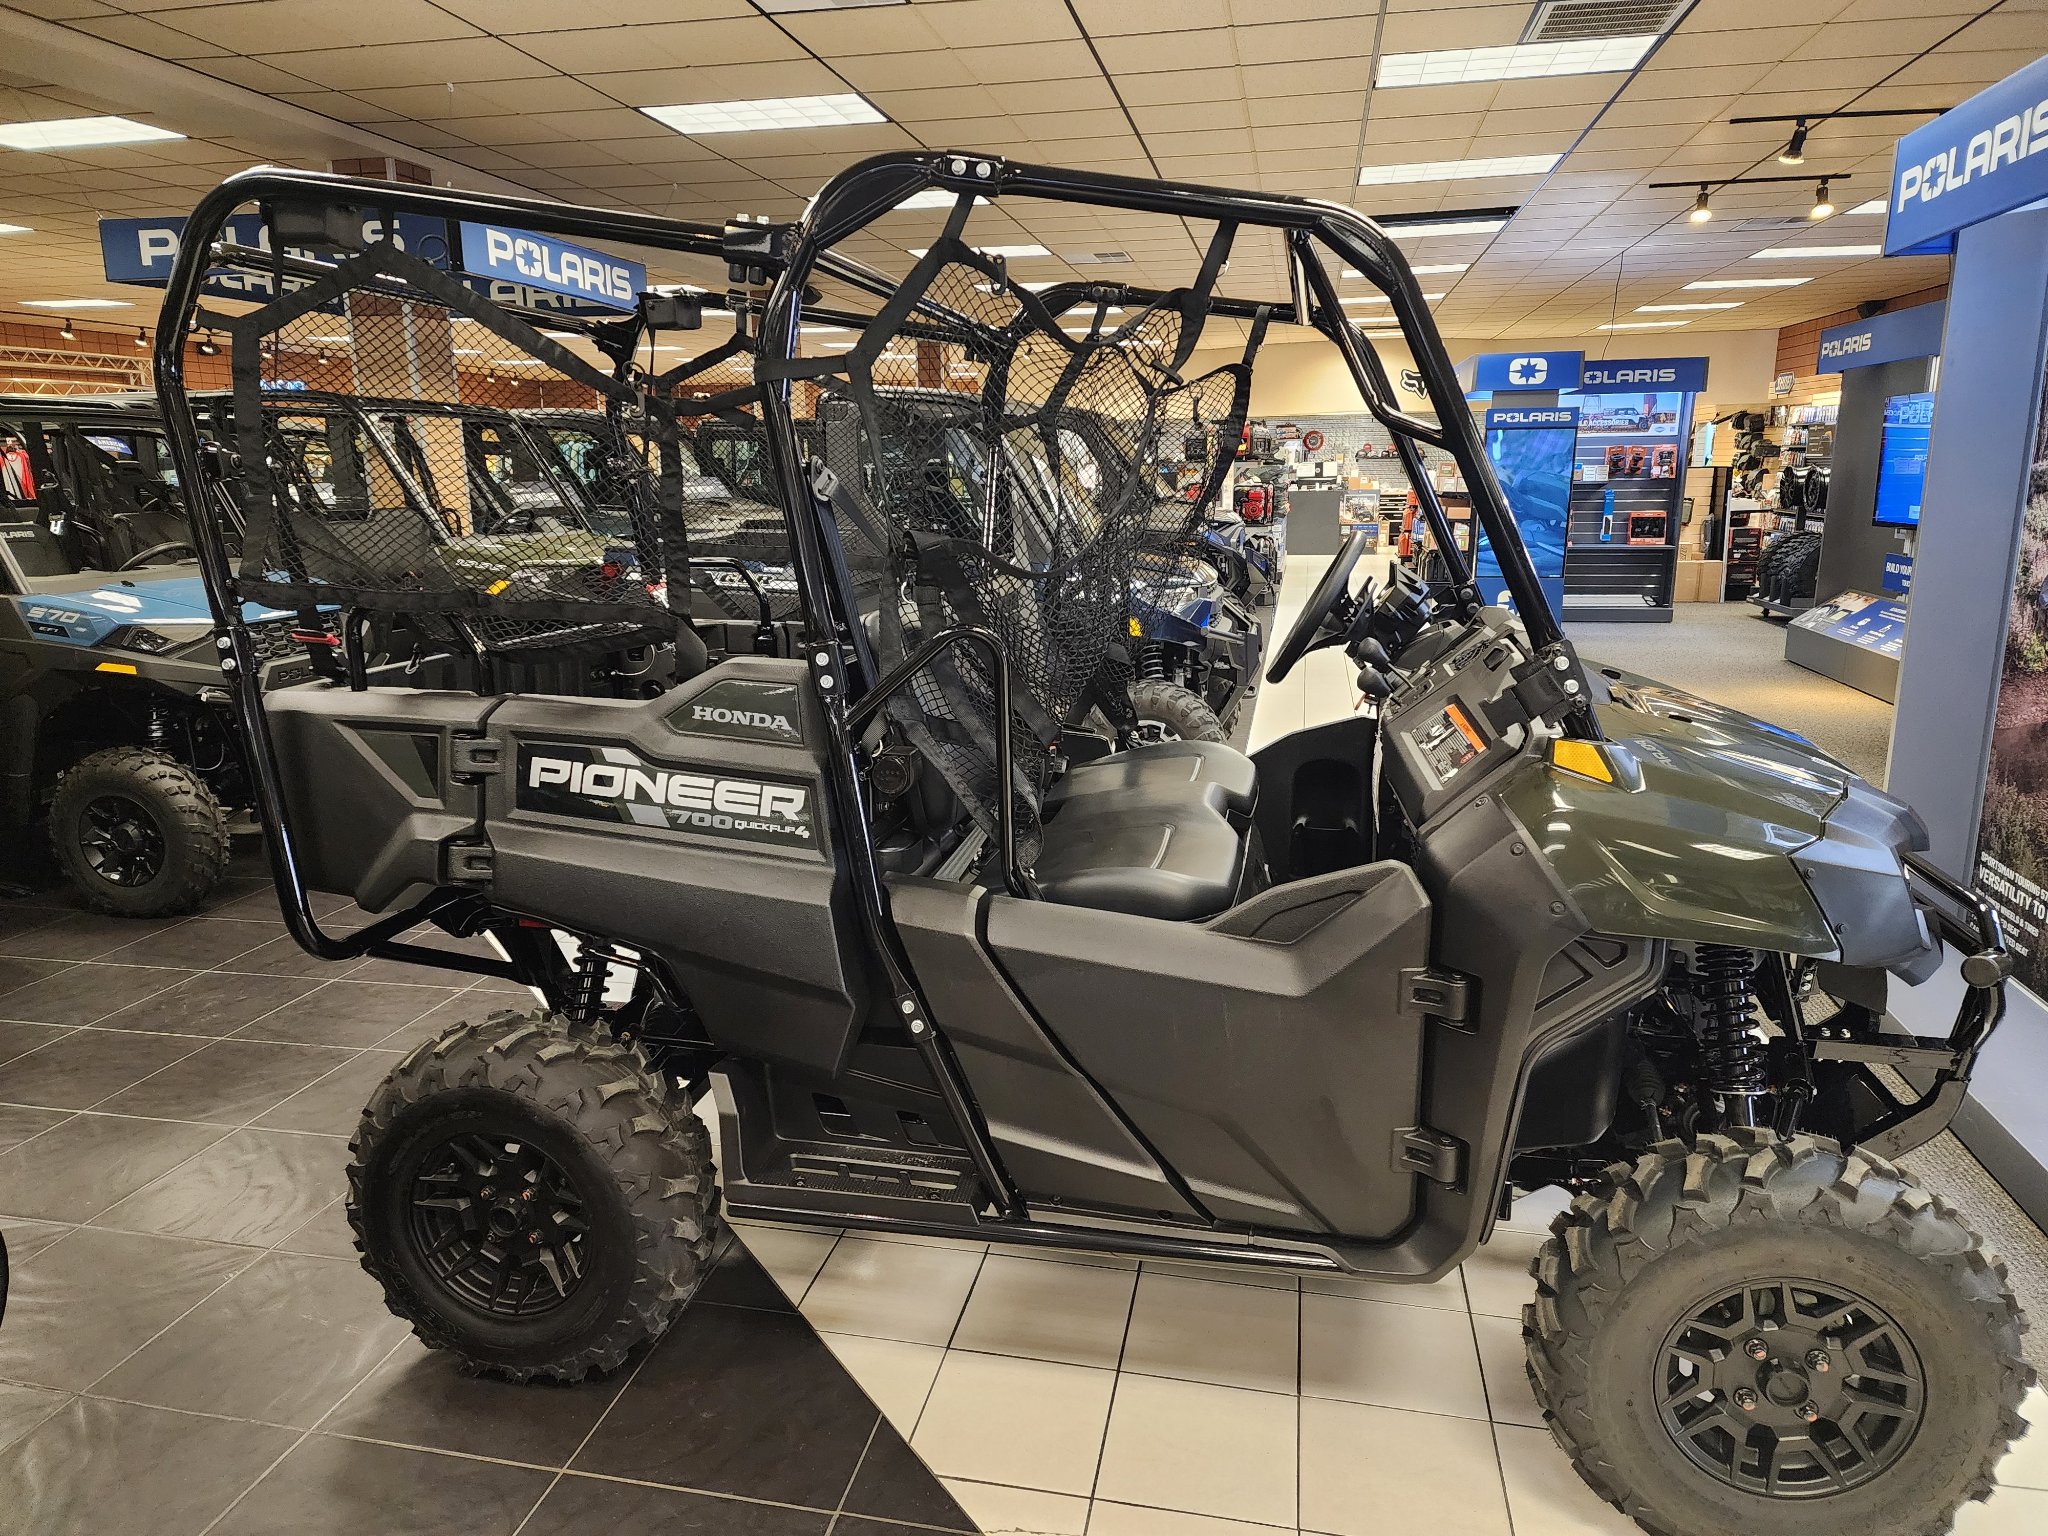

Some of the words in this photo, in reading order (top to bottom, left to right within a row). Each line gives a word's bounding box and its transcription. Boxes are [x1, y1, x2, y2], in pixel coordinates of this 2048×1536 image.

[1897, 99, 2048, 214] POLARIS
[486, 228, 633, 300] POLARIS
[1821, 333, 1872, 359] POLARIS
[1583, 369, 1677, 384] OLARIS
[1493, 411, 1572, 423] POLARIS
[26, 606, 80, 624] 570
[692, 705, 792, 731] HONDA
[529, 756, 807, 821] PIONEER
[671, 810, 734, 830] 700
[1981, 851, 2015, 881] SPORTSMAN
[2014, 872, 2041, 897] TOURING
[1979, 864, 2033, 911] VERSATILITY
[2033, 899, 2046, 920] TO
[2000, 905, 2021, 925] WHEELS
[2024, 920, 2040, 938] TIRES
